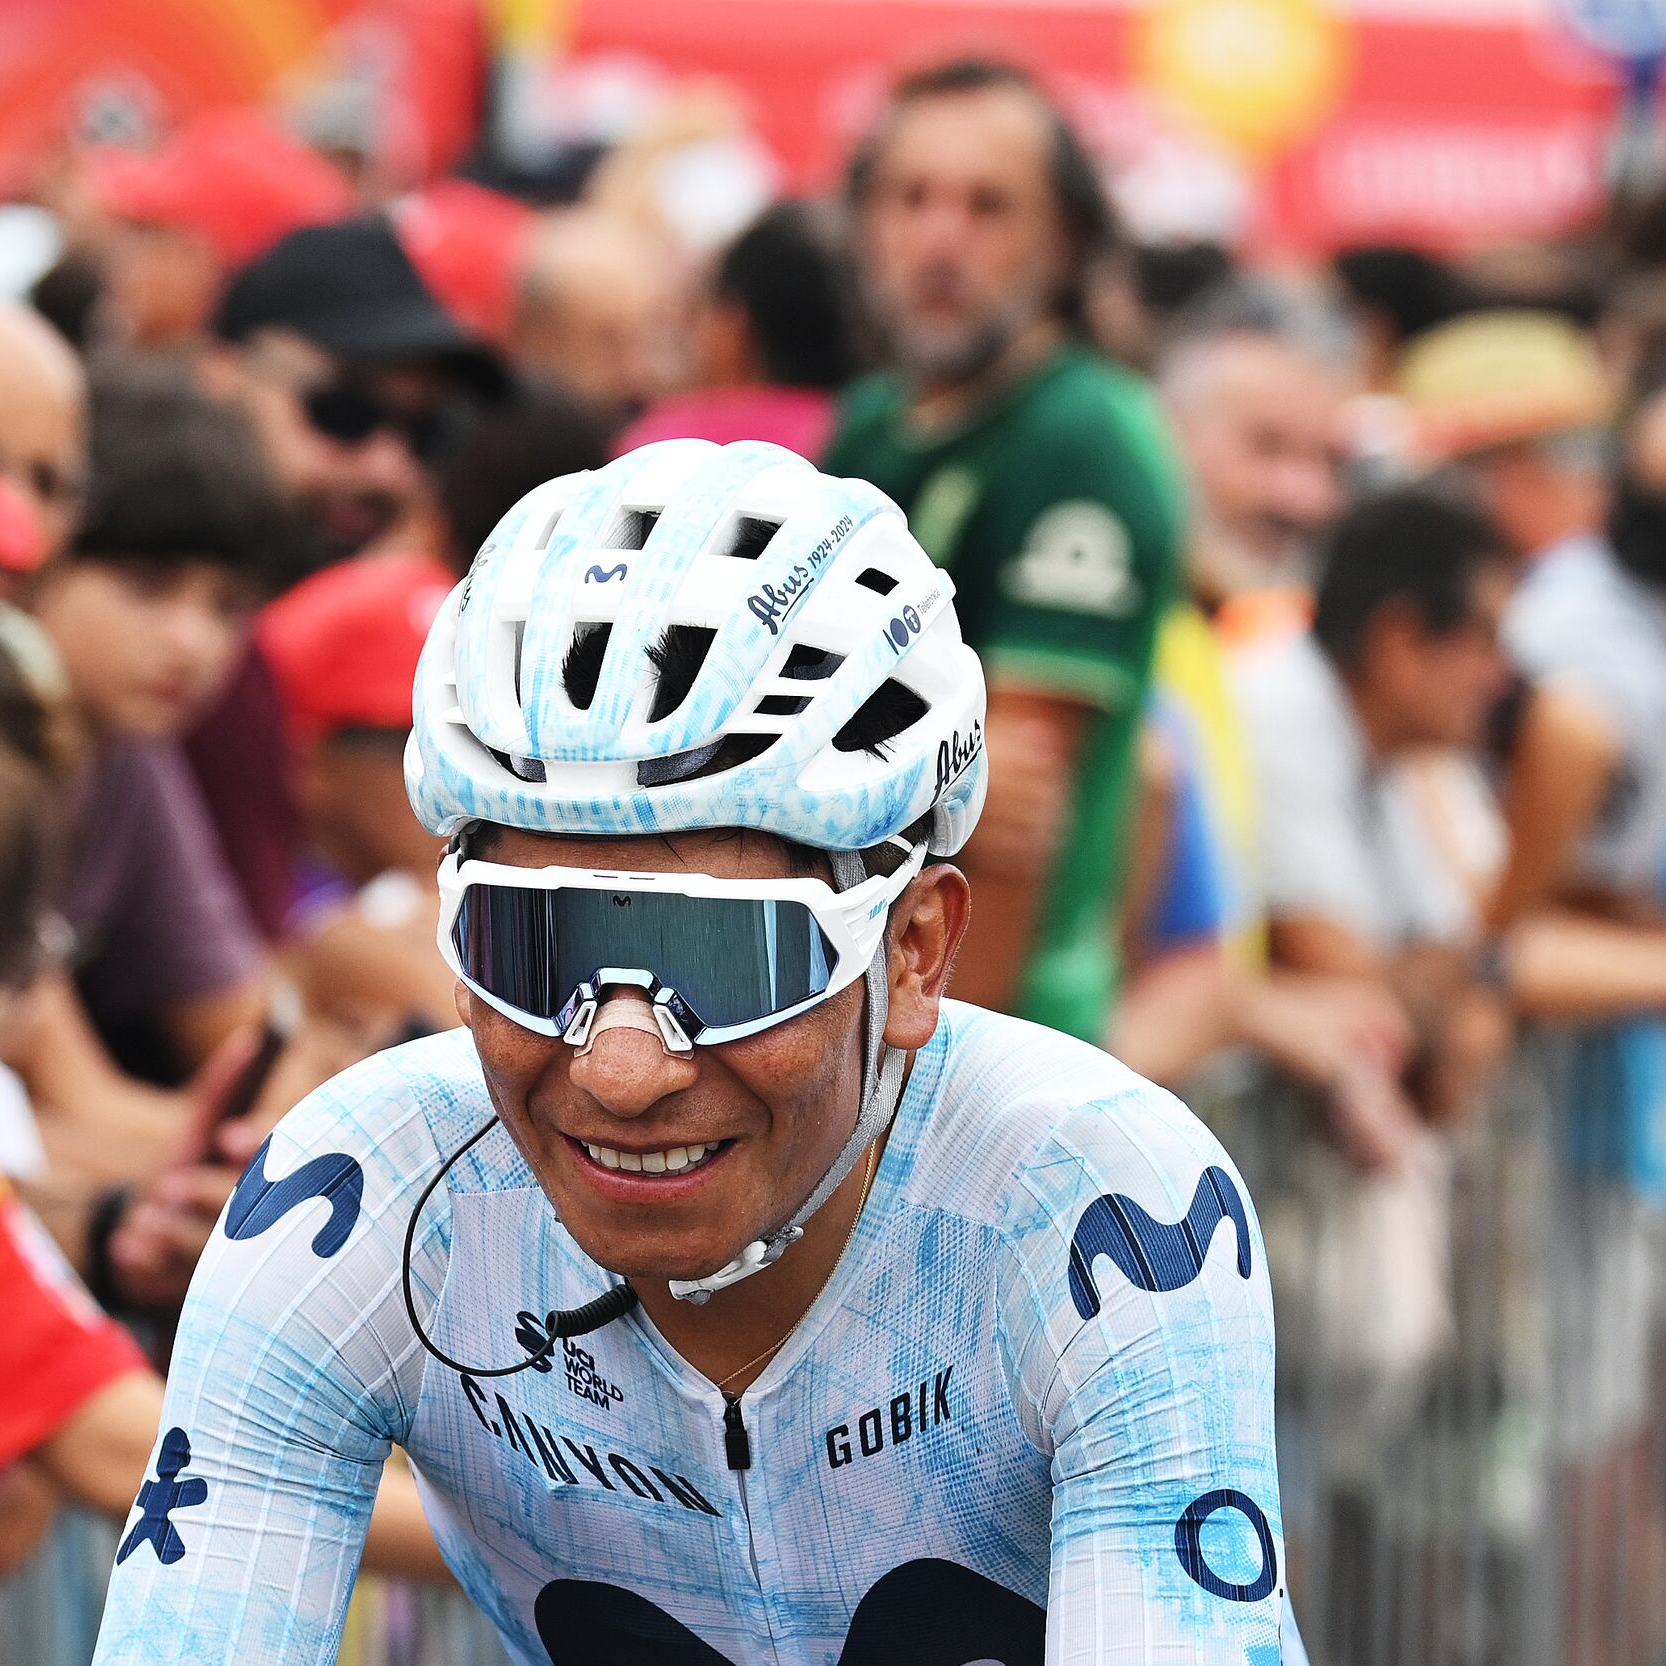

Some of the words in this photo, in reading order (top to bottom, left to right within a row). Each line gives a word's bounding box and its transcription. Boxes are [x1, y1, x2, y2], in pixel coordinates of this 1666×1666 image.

[747, 565, 809, 635] Abus
[807, 514, 854, 570] 1924-2024
[930, 719, 982, 807] Abus
[562, 1337, 596, 1373] UCI
[563, 1352, 624, 1402] WORLD
[564, 1371, 611, 1412] TEAM
[459, 1373, 724, 1518] CANYON
[826, 1364, 955, 1470] GOBIK
